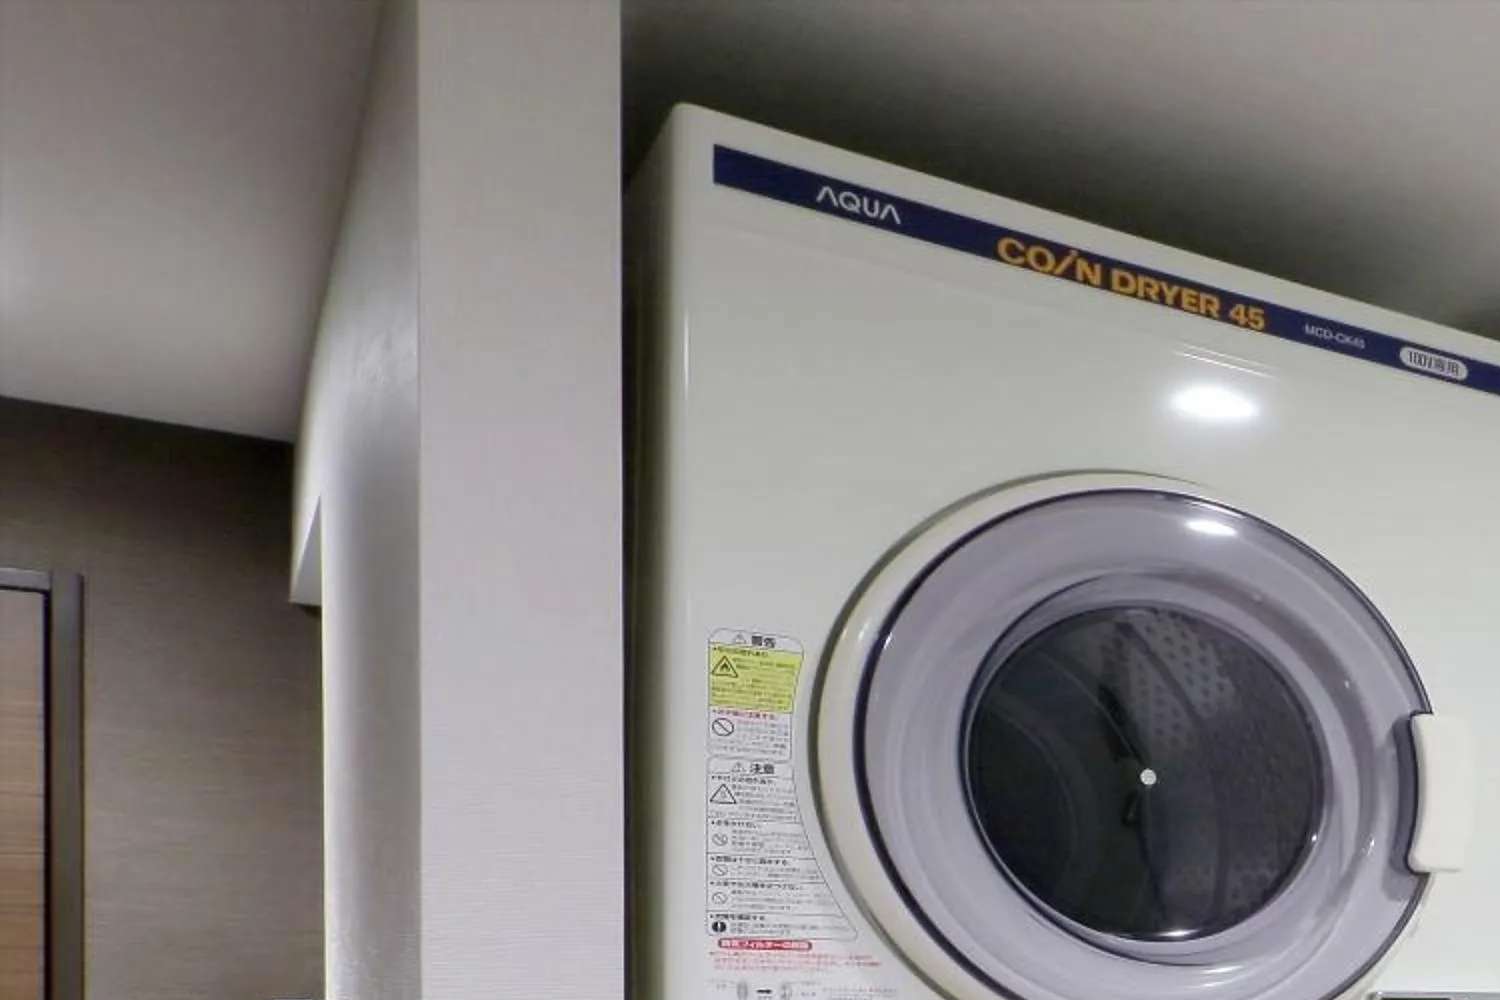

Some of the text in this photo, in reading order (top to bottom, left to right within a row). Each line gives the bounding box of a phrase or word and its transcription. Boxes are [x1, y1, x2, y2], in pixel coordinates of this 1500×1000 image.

[816, 186, 901, 225] AQUA
[1112, 268, 1220, 318] DRYER
[1229, 303, 1265, 331] 45
